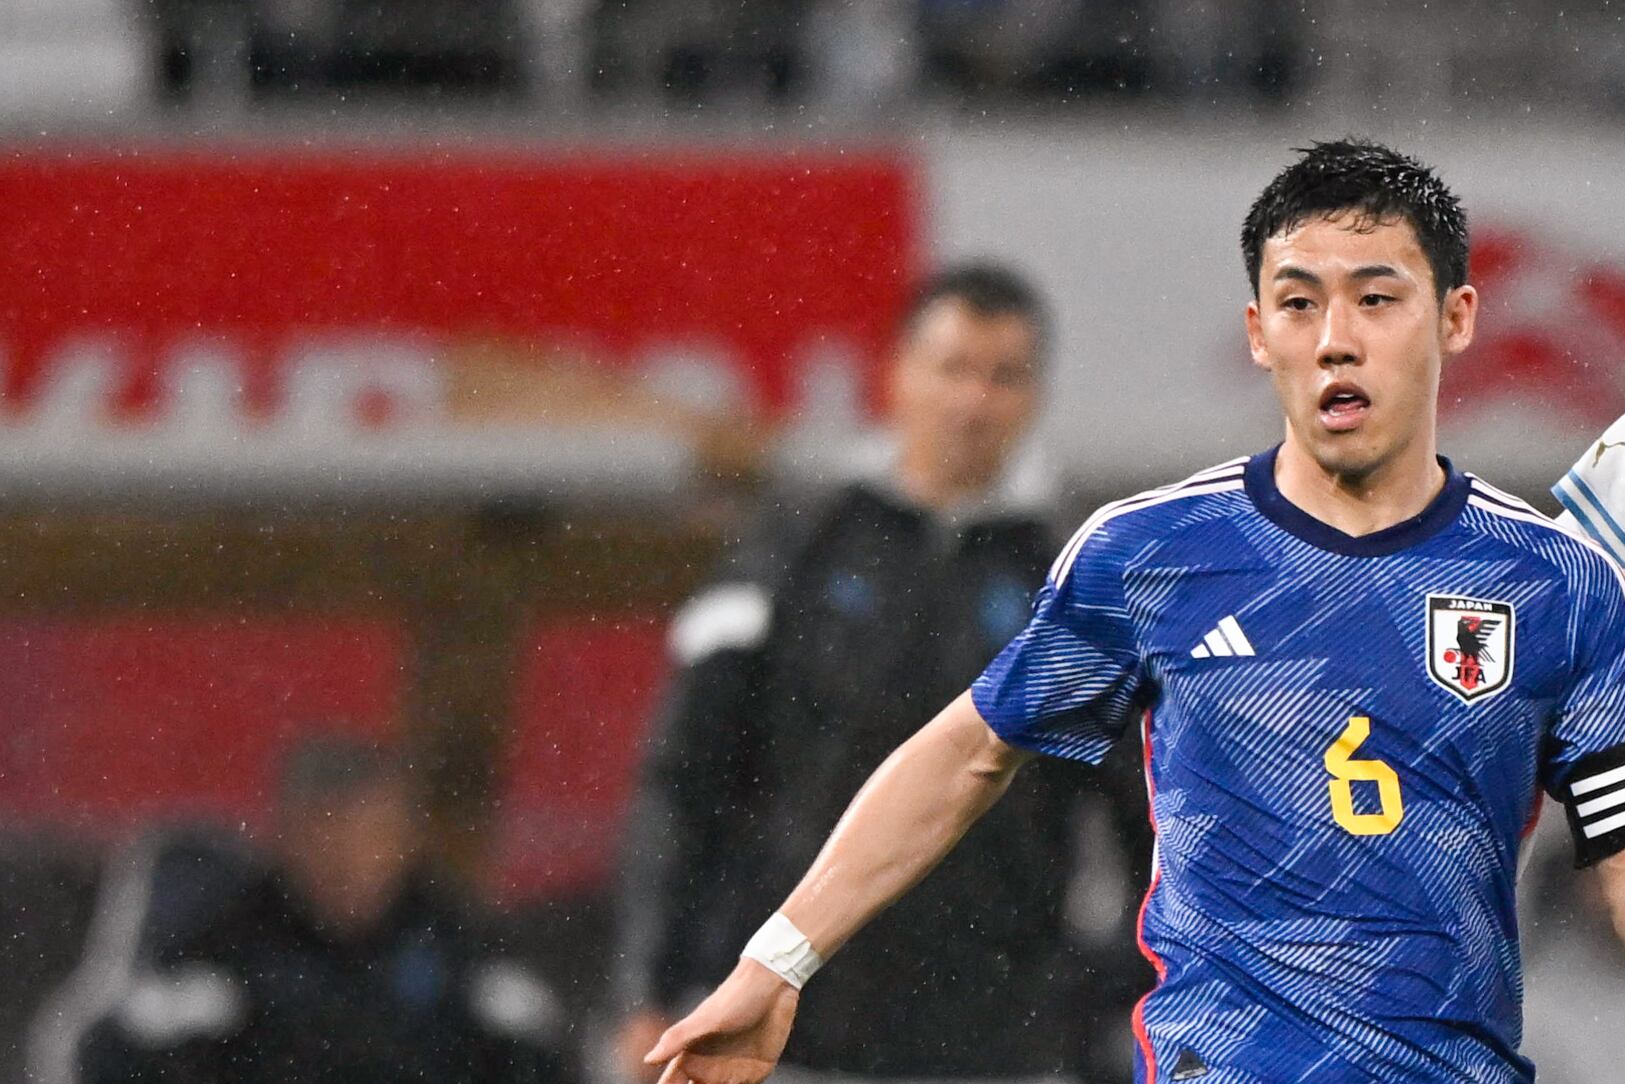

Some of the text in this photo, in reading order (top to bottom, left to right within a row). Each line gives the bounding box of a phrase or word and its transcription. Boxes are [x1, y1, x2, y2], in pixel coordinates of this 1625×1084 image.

[1448, 599, 1493, 611] JAPAN
[1452, 666, 1487, 684] JFA
[1324, 716, 1404, 835] 6
